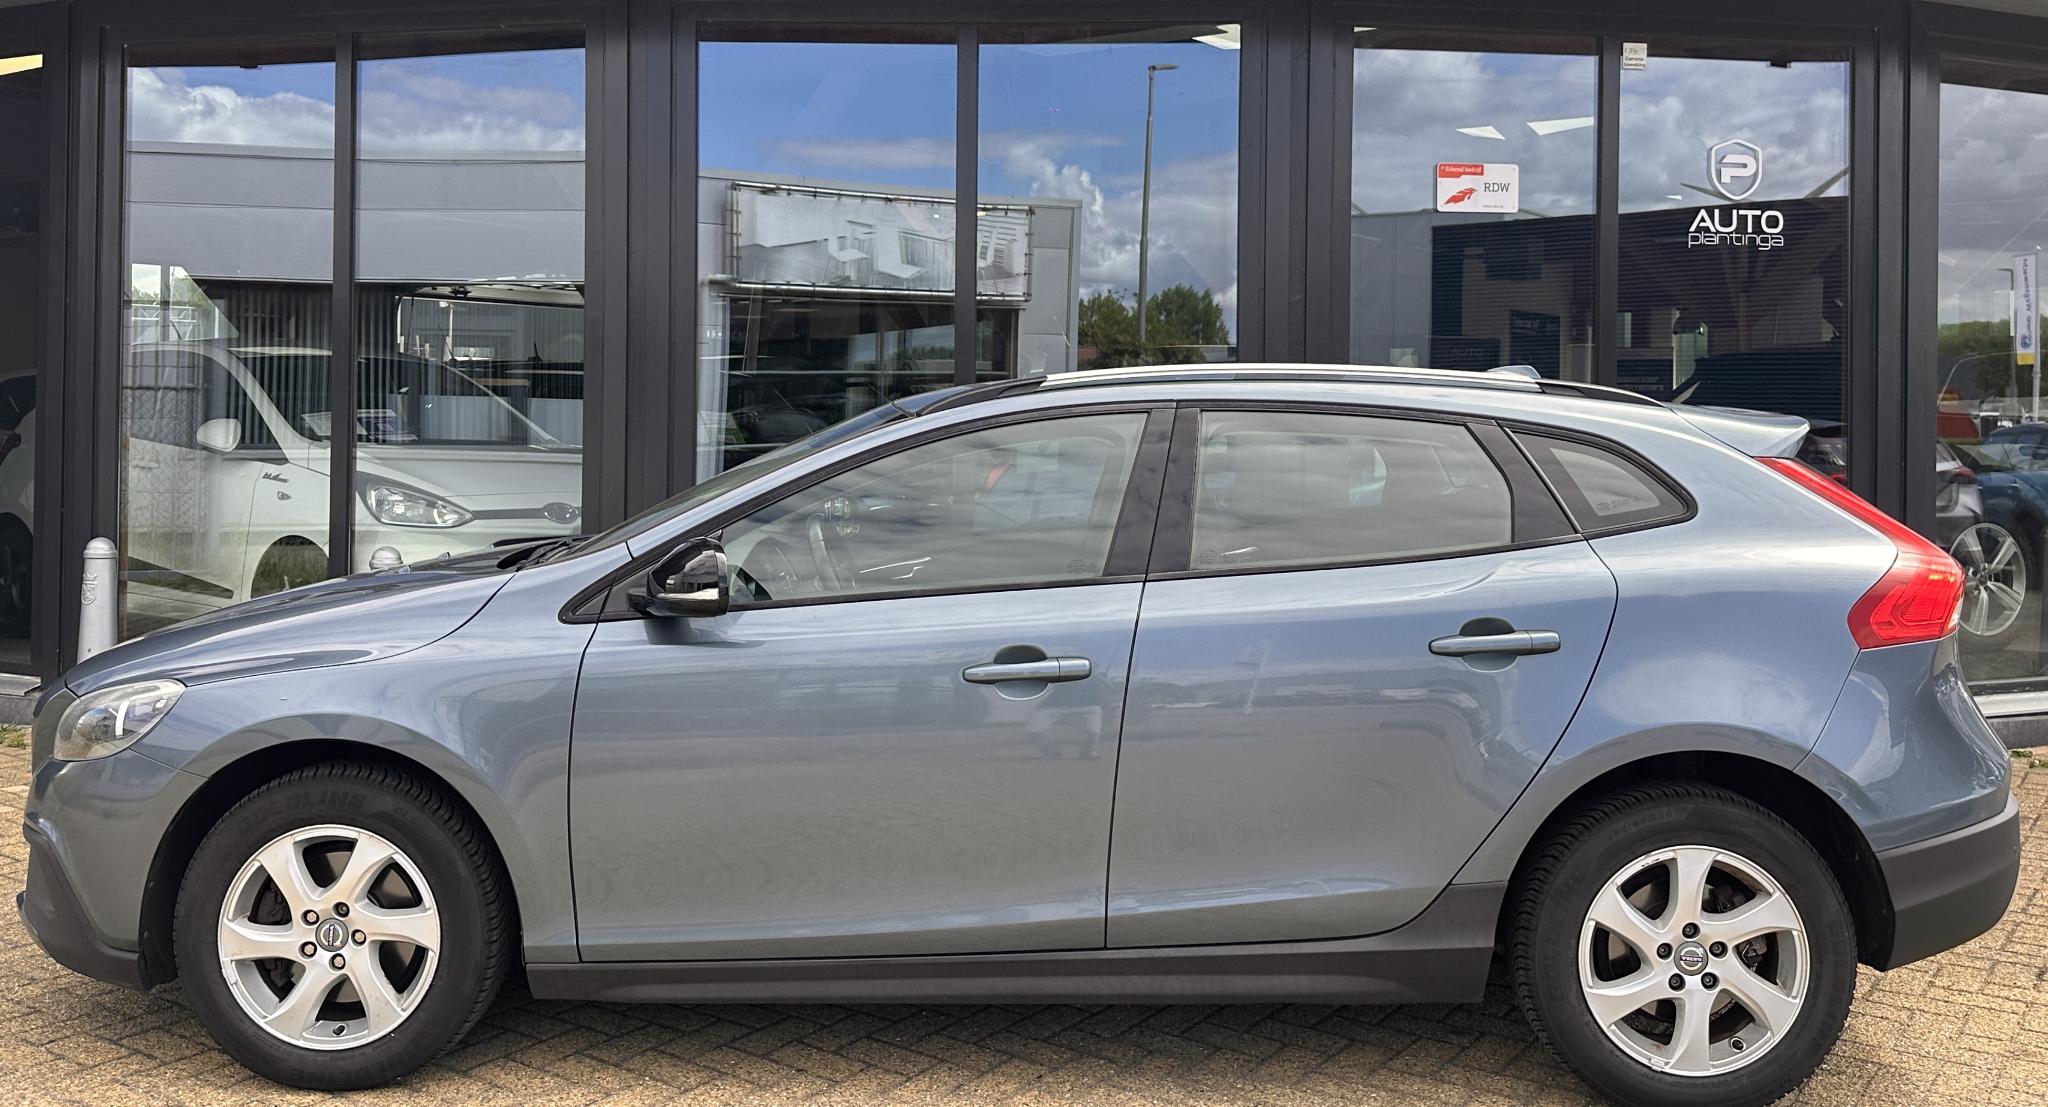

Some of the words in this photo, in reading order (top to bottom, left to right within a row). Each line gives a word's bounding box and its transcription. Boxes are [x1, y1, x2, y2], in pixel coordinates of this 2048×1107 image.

[1483, 182, 1511, 193] RDW
[1688, 208, 1784, 234] AUTO
[1688, 230, 1784, 251] plantinga
